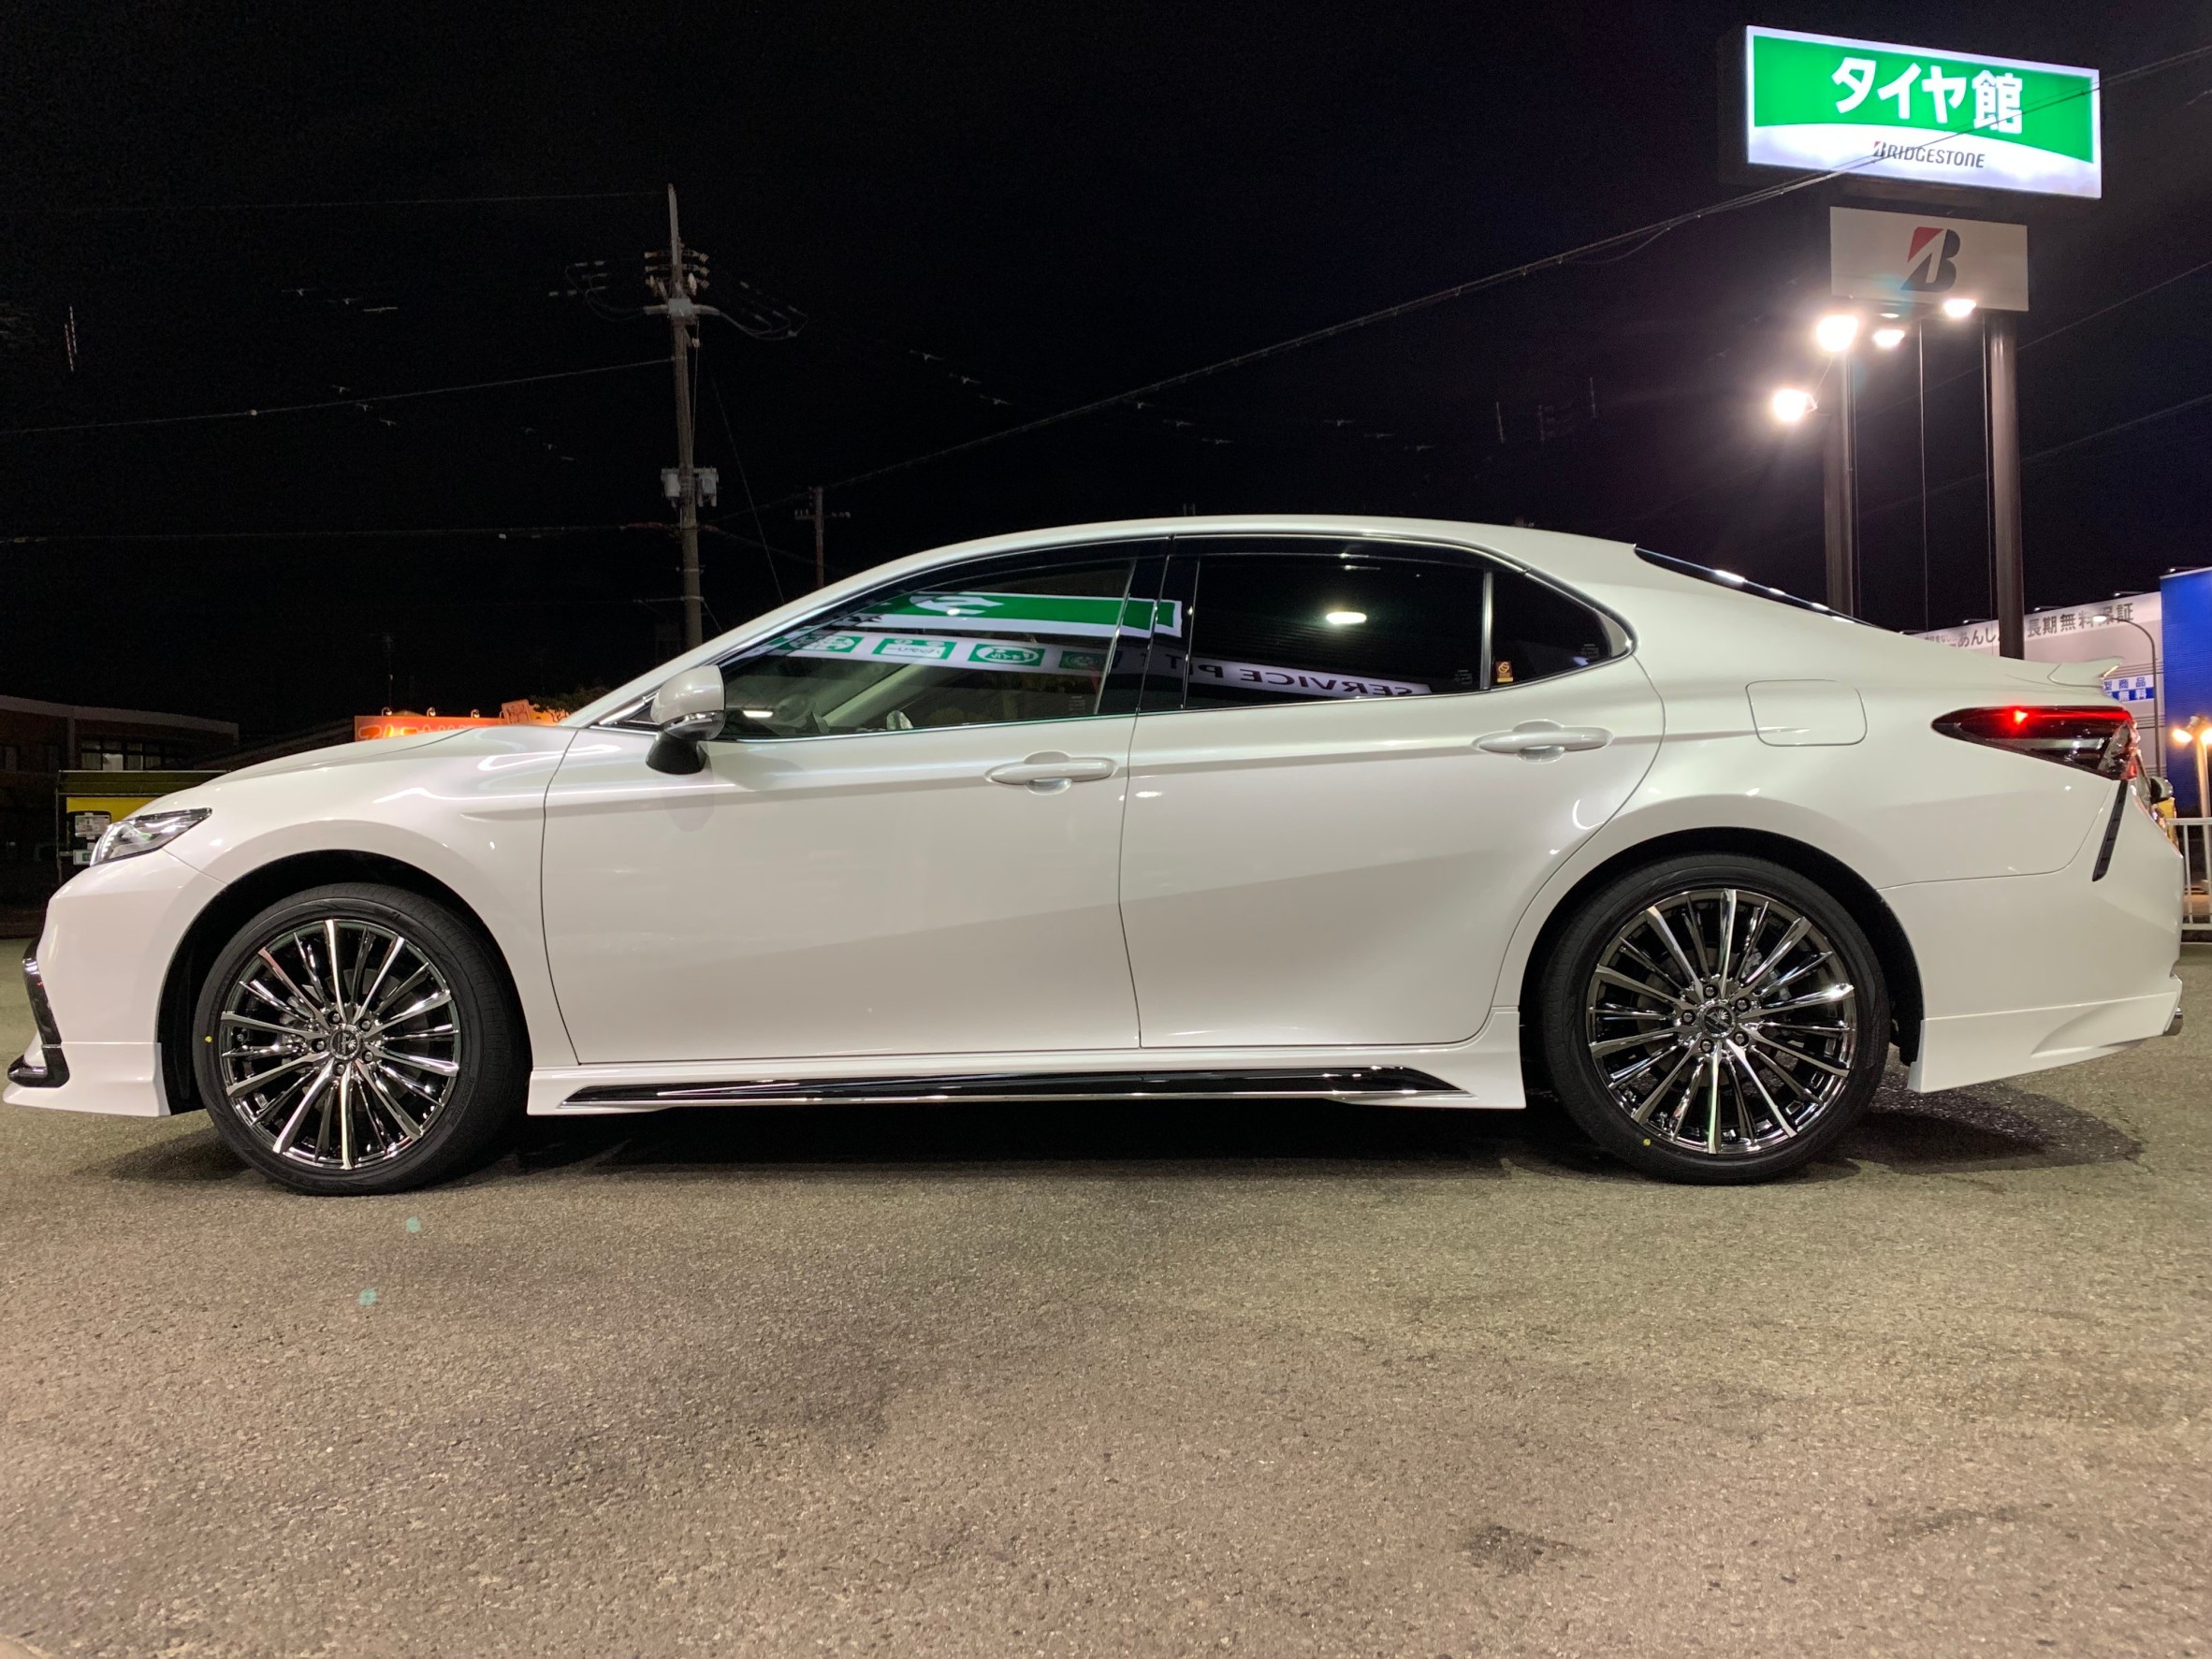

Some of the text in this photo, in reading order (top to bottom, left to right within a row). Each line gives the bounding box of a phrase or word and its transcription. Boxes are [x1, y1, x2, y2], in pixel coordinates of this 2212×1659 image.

[1831, 57, 2022, 134] タイヤ館
[1873, 141, 1986, 168] BRIDGESTONE
